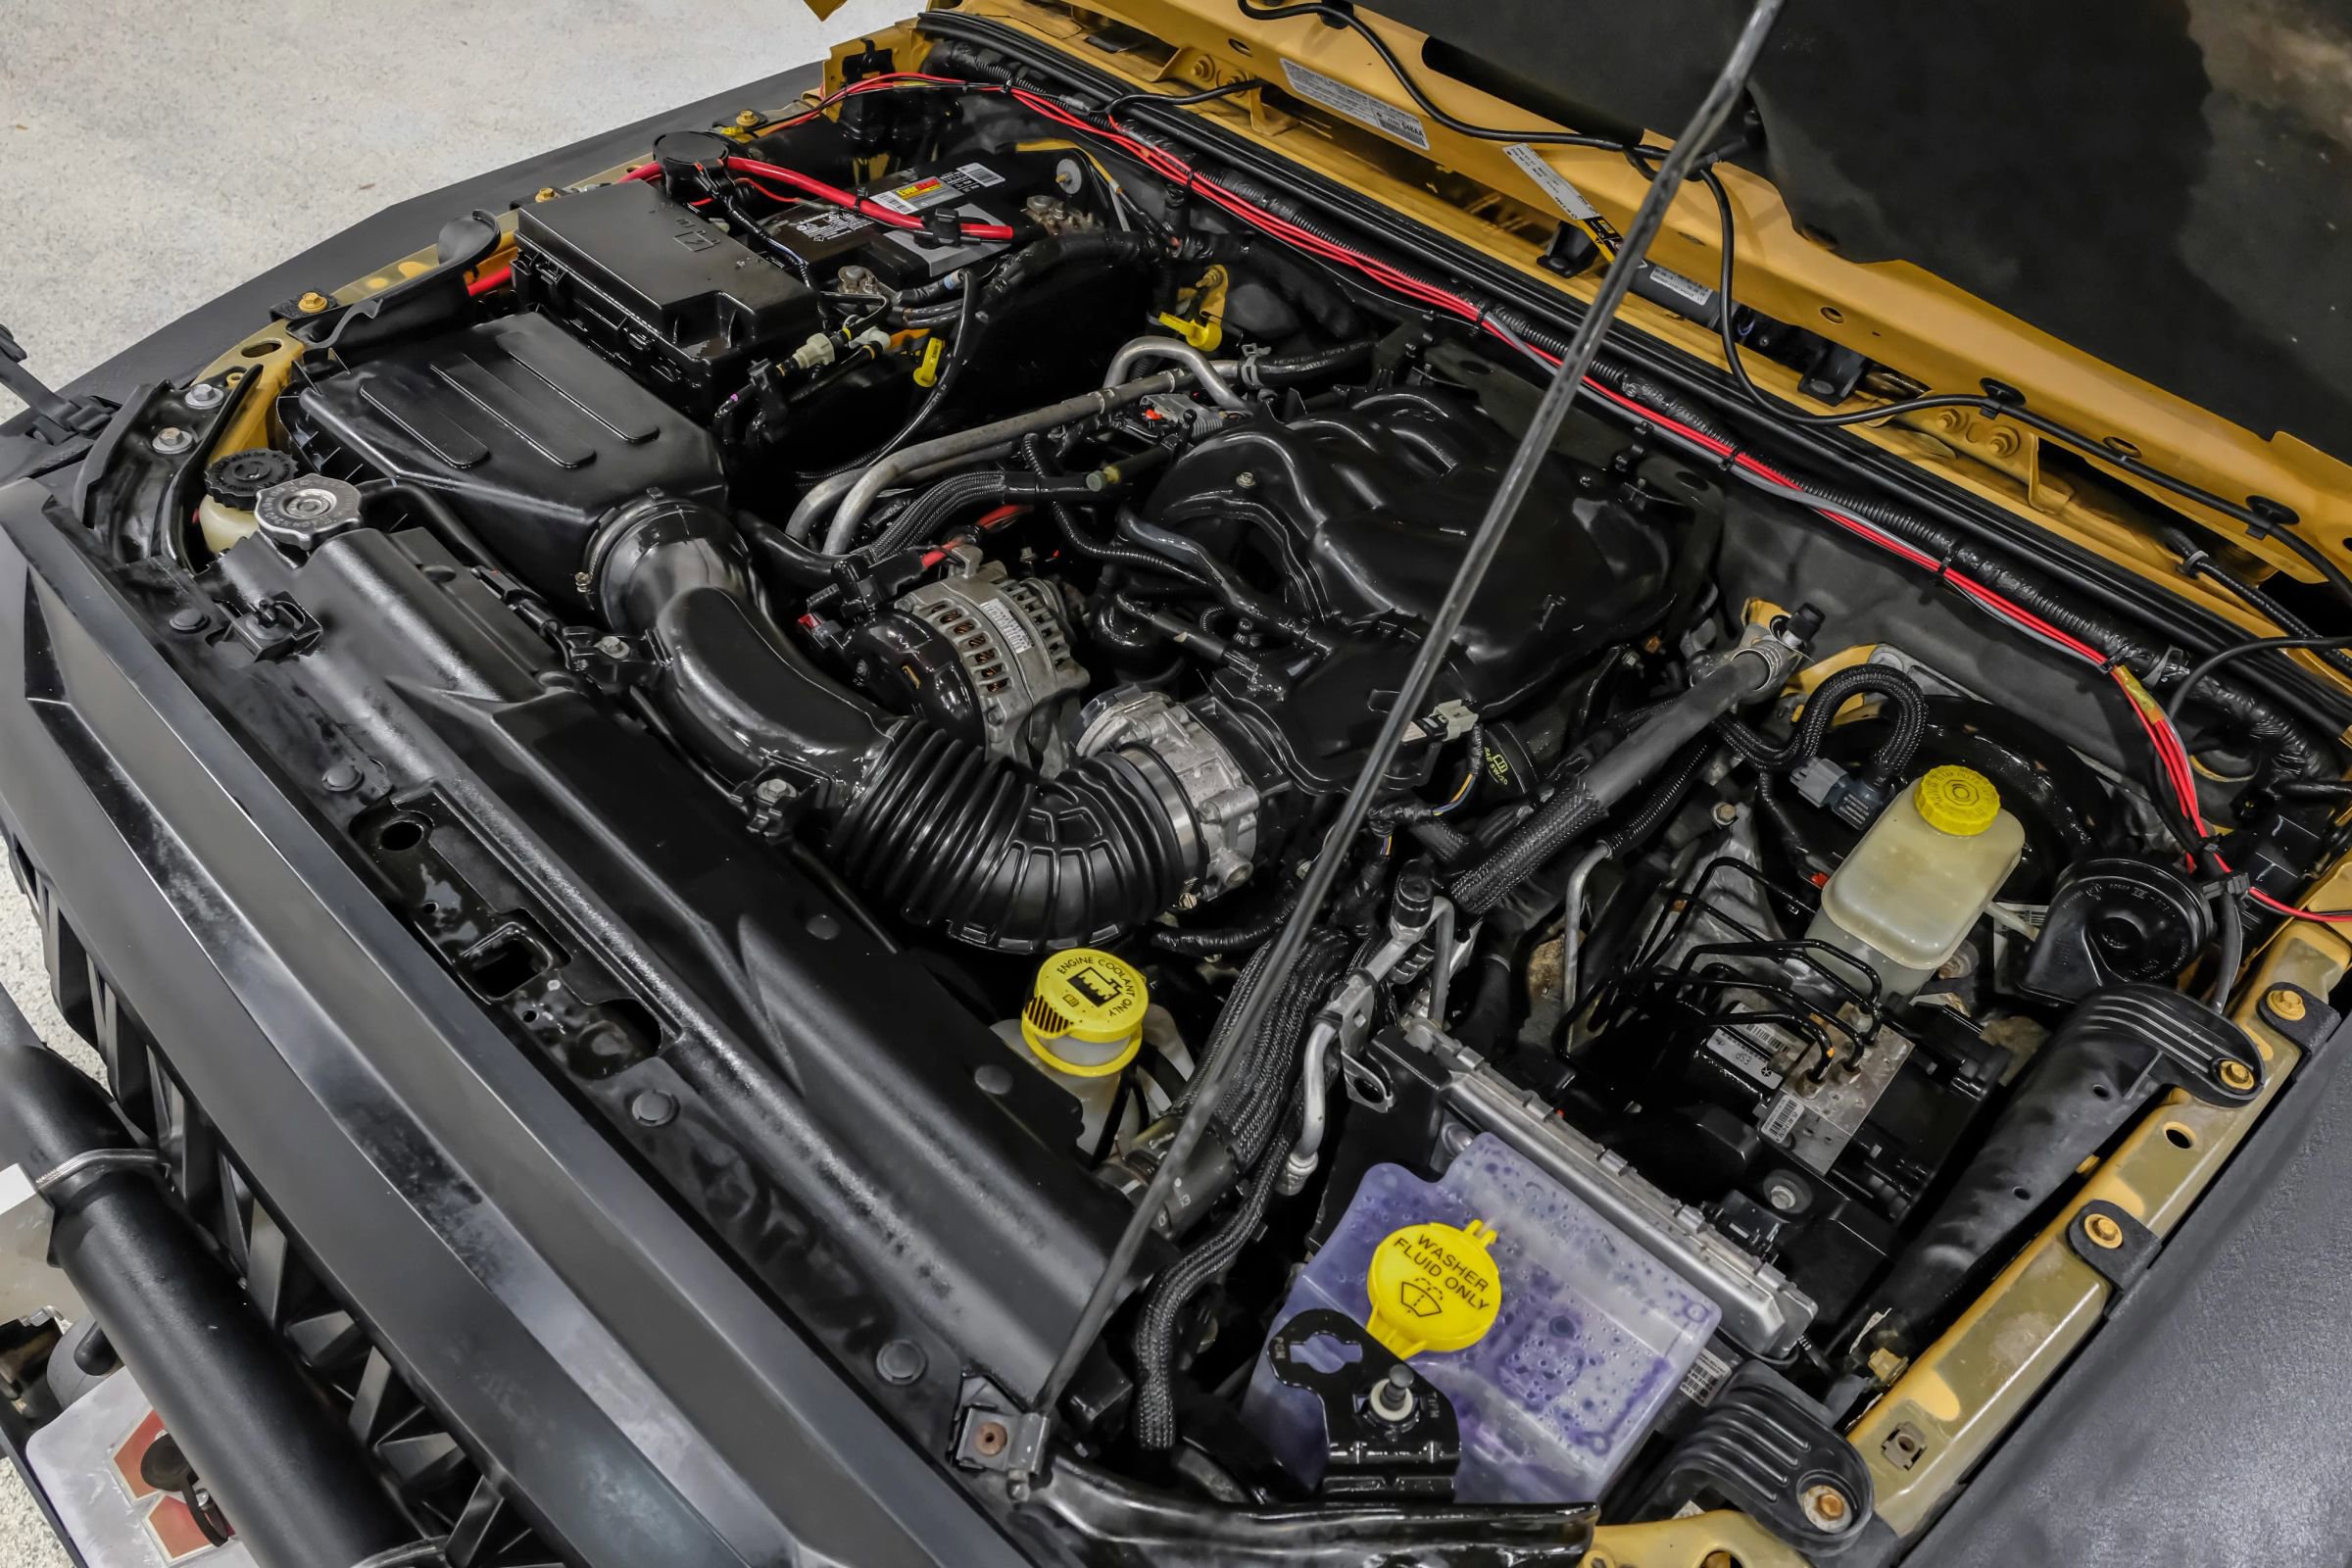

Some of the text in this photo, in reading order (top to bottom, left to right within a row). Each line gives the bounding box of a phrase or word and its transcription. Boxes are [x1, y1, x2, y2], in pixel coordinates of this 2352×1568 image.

[1056, 956, 1136, 1017] ENGINE COOLANT ONLY
[1394, 1237, 1490, 1310] FLUID ONLY
[1418, 1234, 1489, 1293] WASHER
